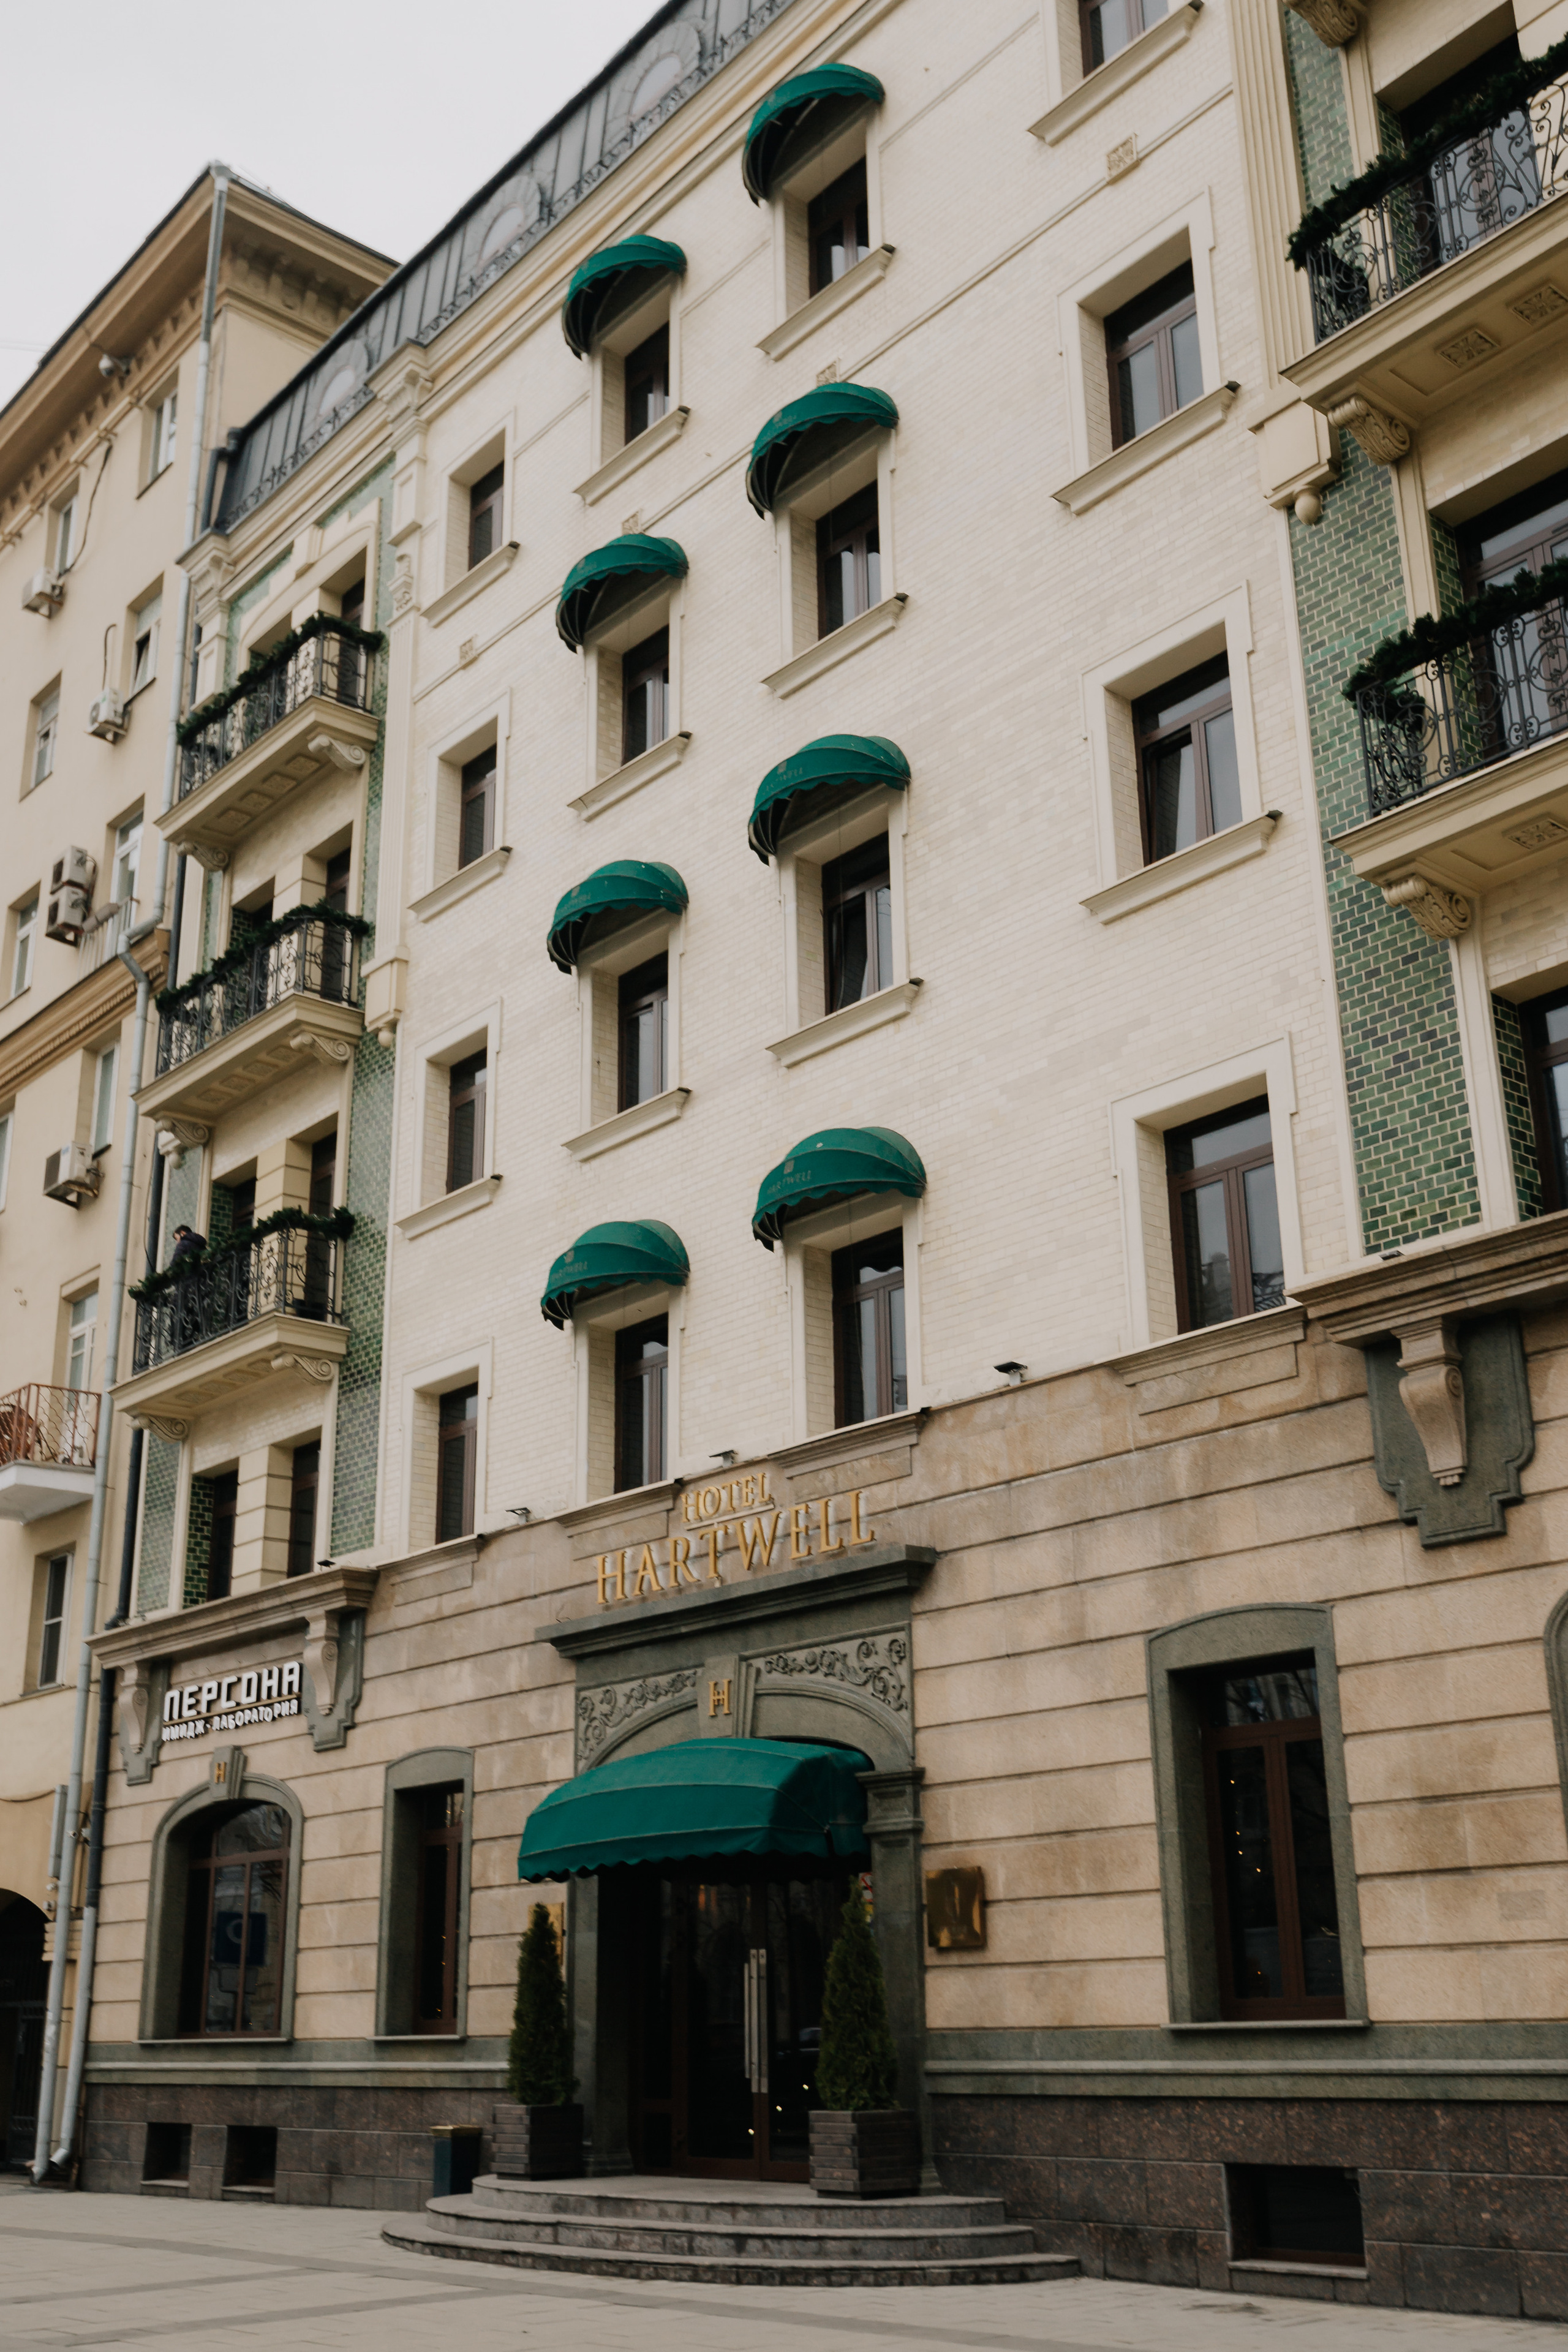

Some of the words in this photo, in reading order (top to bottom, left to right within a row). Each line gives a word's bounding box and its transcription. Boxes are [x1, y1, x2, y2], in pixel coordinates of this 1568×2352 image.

[680, 1472, 774, 1524] HOTEL
[596, 1490, 876, 1605] HARTWELL
[163, 1660, 301, 1722] ПЕРСОНА
